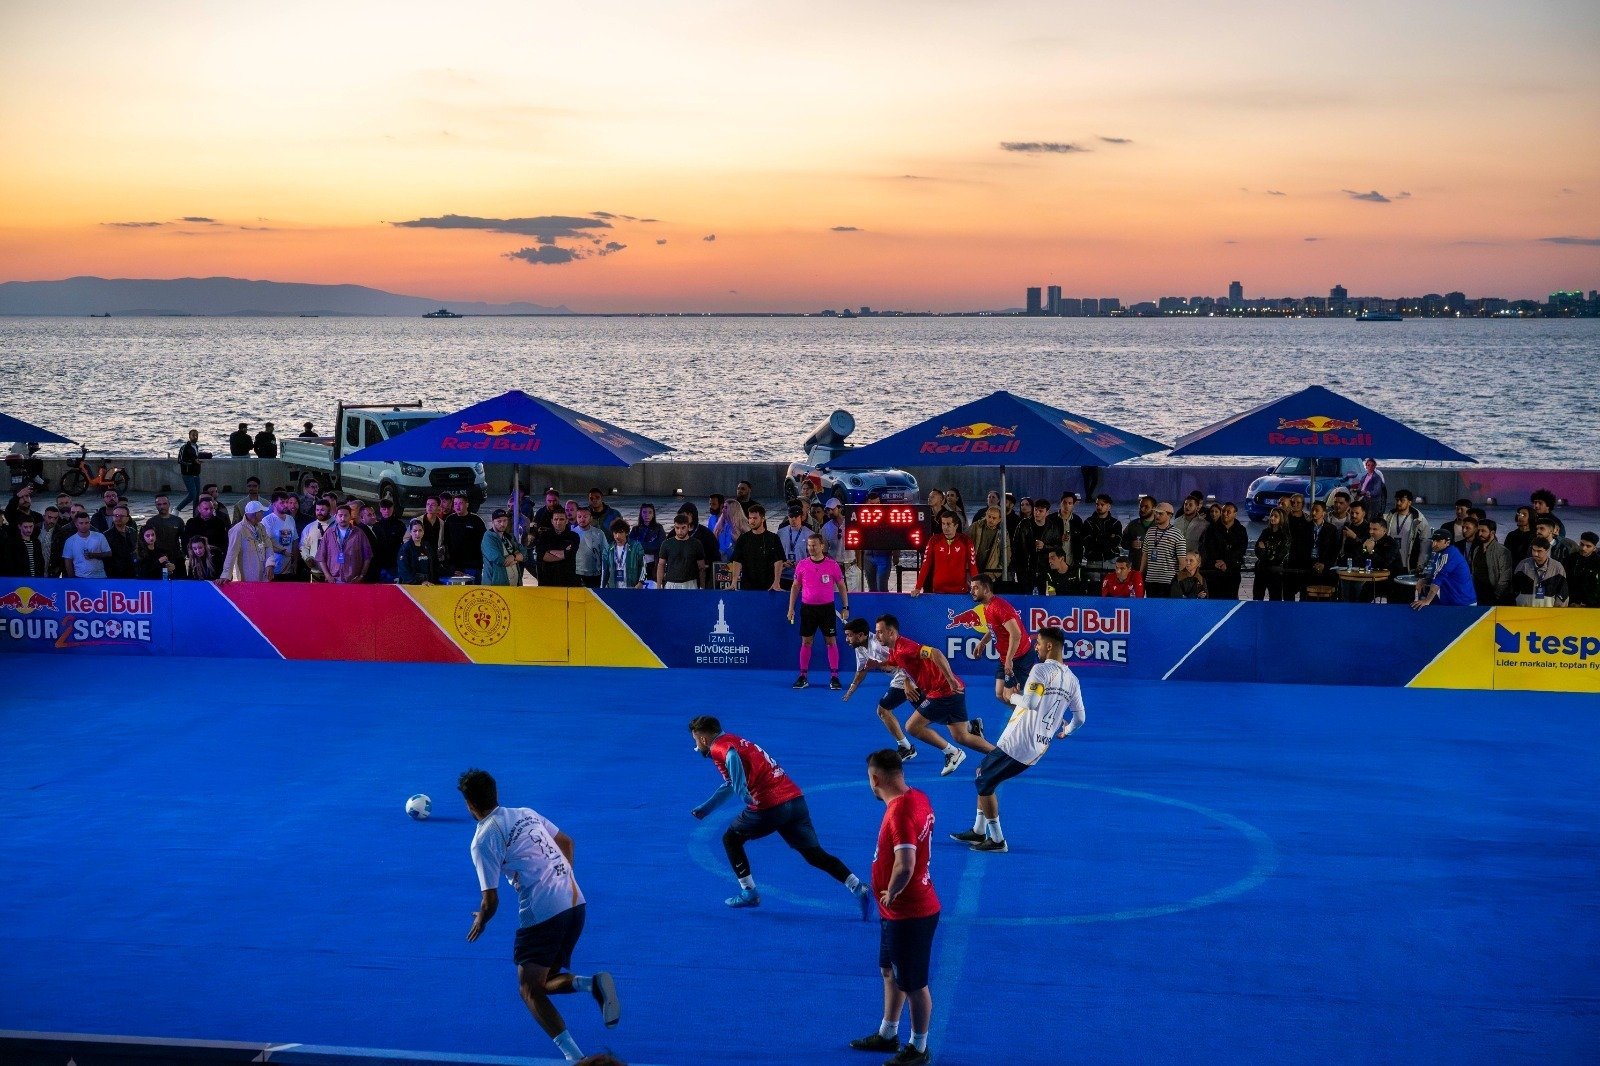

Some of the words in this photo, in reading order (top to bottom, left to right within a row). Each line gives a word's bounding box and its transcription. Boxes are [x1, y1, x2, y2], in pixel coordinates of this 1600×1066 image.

[440, 436, 492, 450] Red
[493, 437, 541, 452] Bull
[920, 440, 971, 454] Red
[971, 439, 1021, 453] Bull
[1268, 432, 1319, 445] Red
[1322, 433, 1373, 446] Bull
[850, 511, 858, 522] A
[917, 511, 925, 522] B
[65, 589, 108, 613] Red
[110, 591, 152, 614] Bull
[1029, 607, 1079, 633] Red
[1082, 609, 1131, 634] Bull
[694, 644, 750, 655] BÜYÜKŞEHİR
[1062, 639, 1127, 662] CORE
[696, 655, 748, 664] BELEDİYESİ
[1496, 659, 1518, 667] Lider
[1520, 660, 1558, 669] markalar,
[1559, 661, 1588, 670] toptan
[1589, 662, 1600, 671] fiy
[1042, 699, 1060, 731] 4
